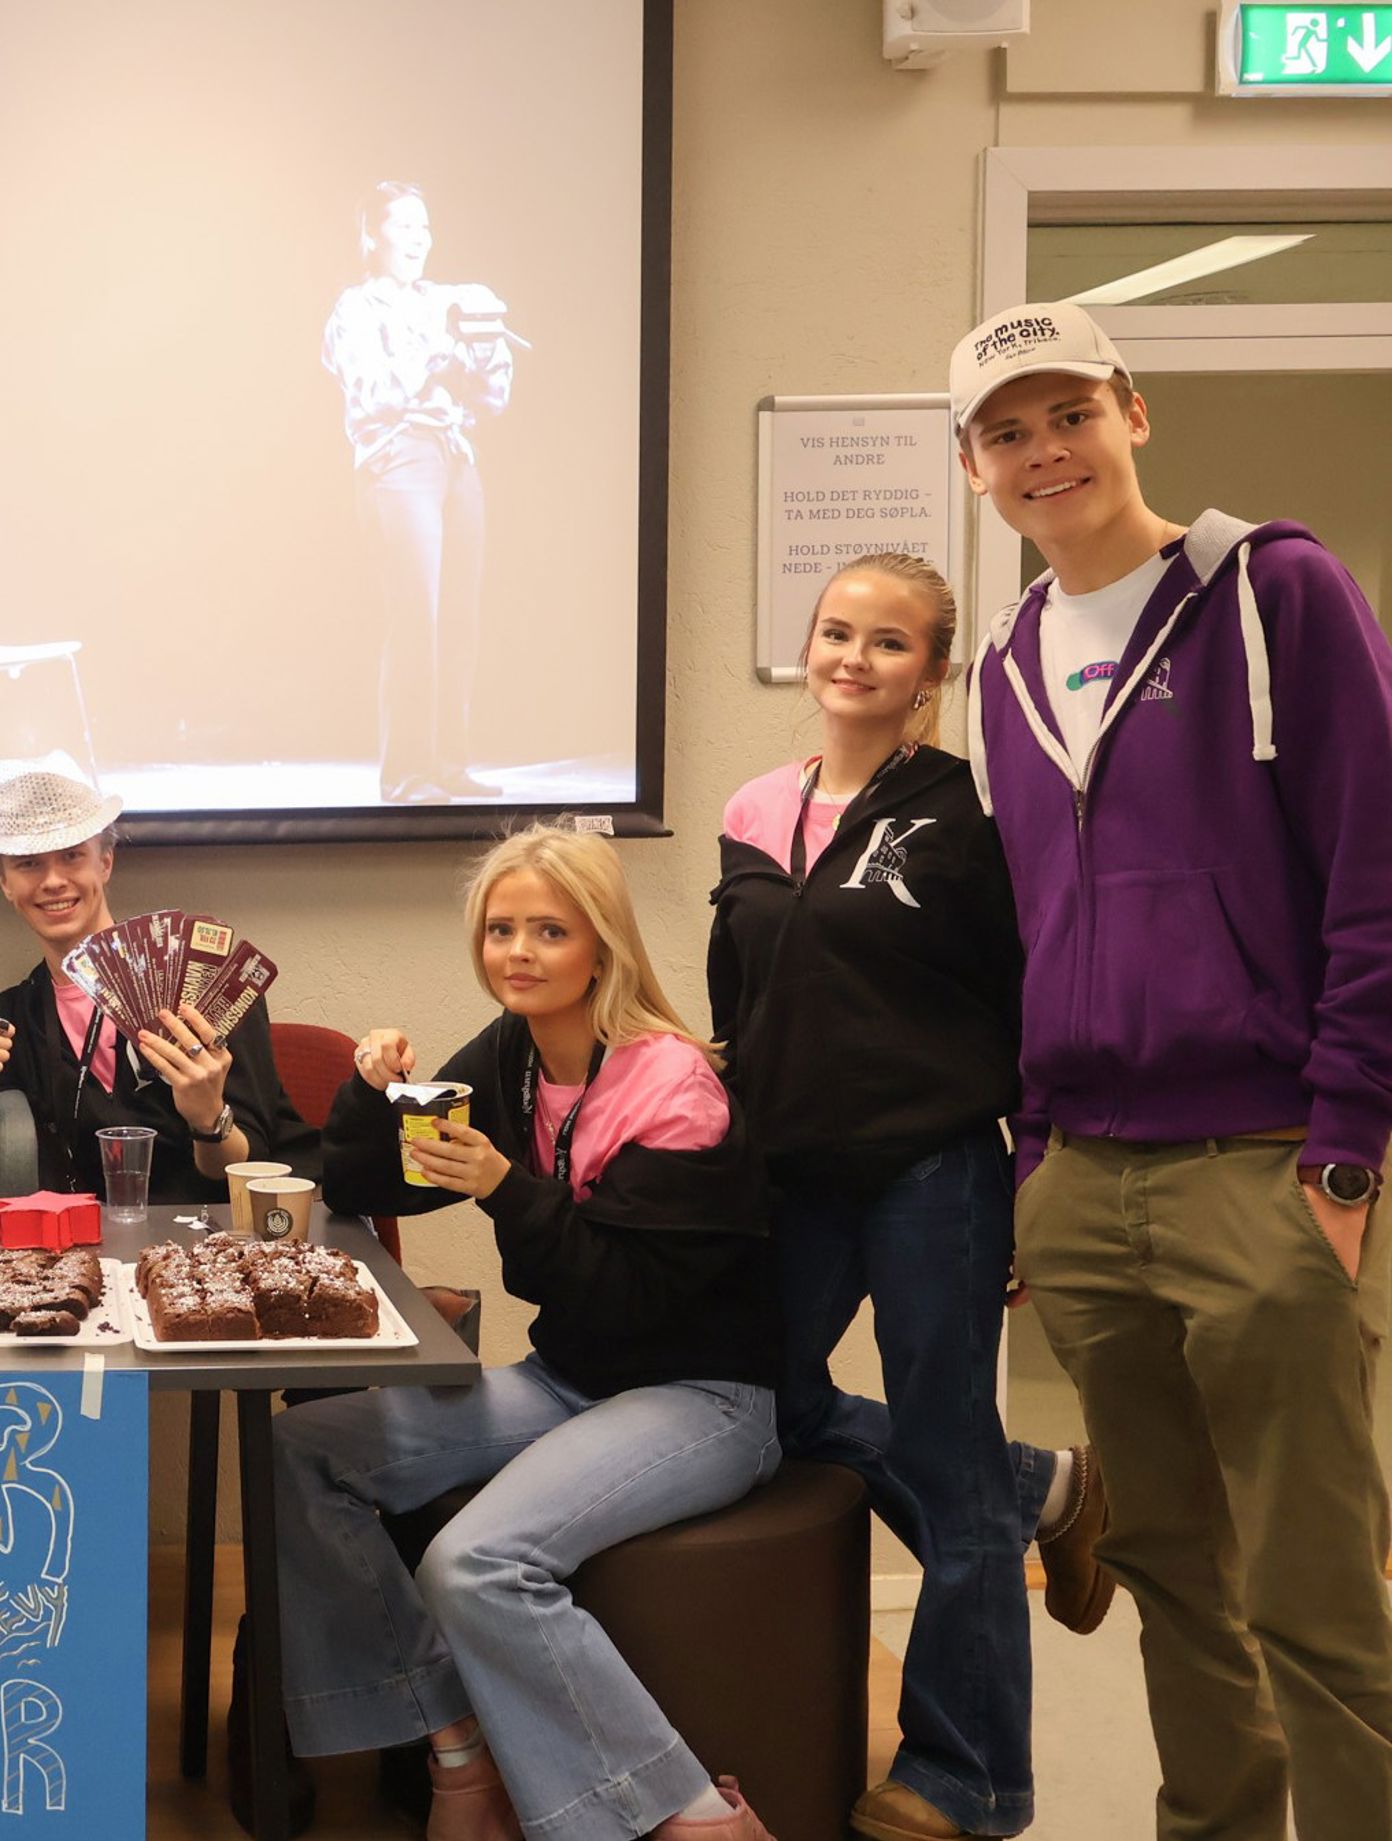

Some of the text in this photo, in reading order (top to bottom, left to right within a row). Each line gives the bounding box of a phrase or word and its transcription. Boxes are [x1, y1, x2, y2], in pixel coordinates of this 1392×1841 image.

[800, 435, 917, 449] VIS HENSYN TIL
[833, 453, 886, 466] ANDRE
[783, 490, 826, 502] HOLD
[830, 490, 859, 501] DET
[863, 488, 920, 500] RYDDIG
[785, 506, 932, 520] TA MED DEG SØPLA.
[788, 539, 928, 556] HOLD STØYNIVÅET
[782, 562, 822, 574] NEDE
[1084, 663, 1115, 679] Off
